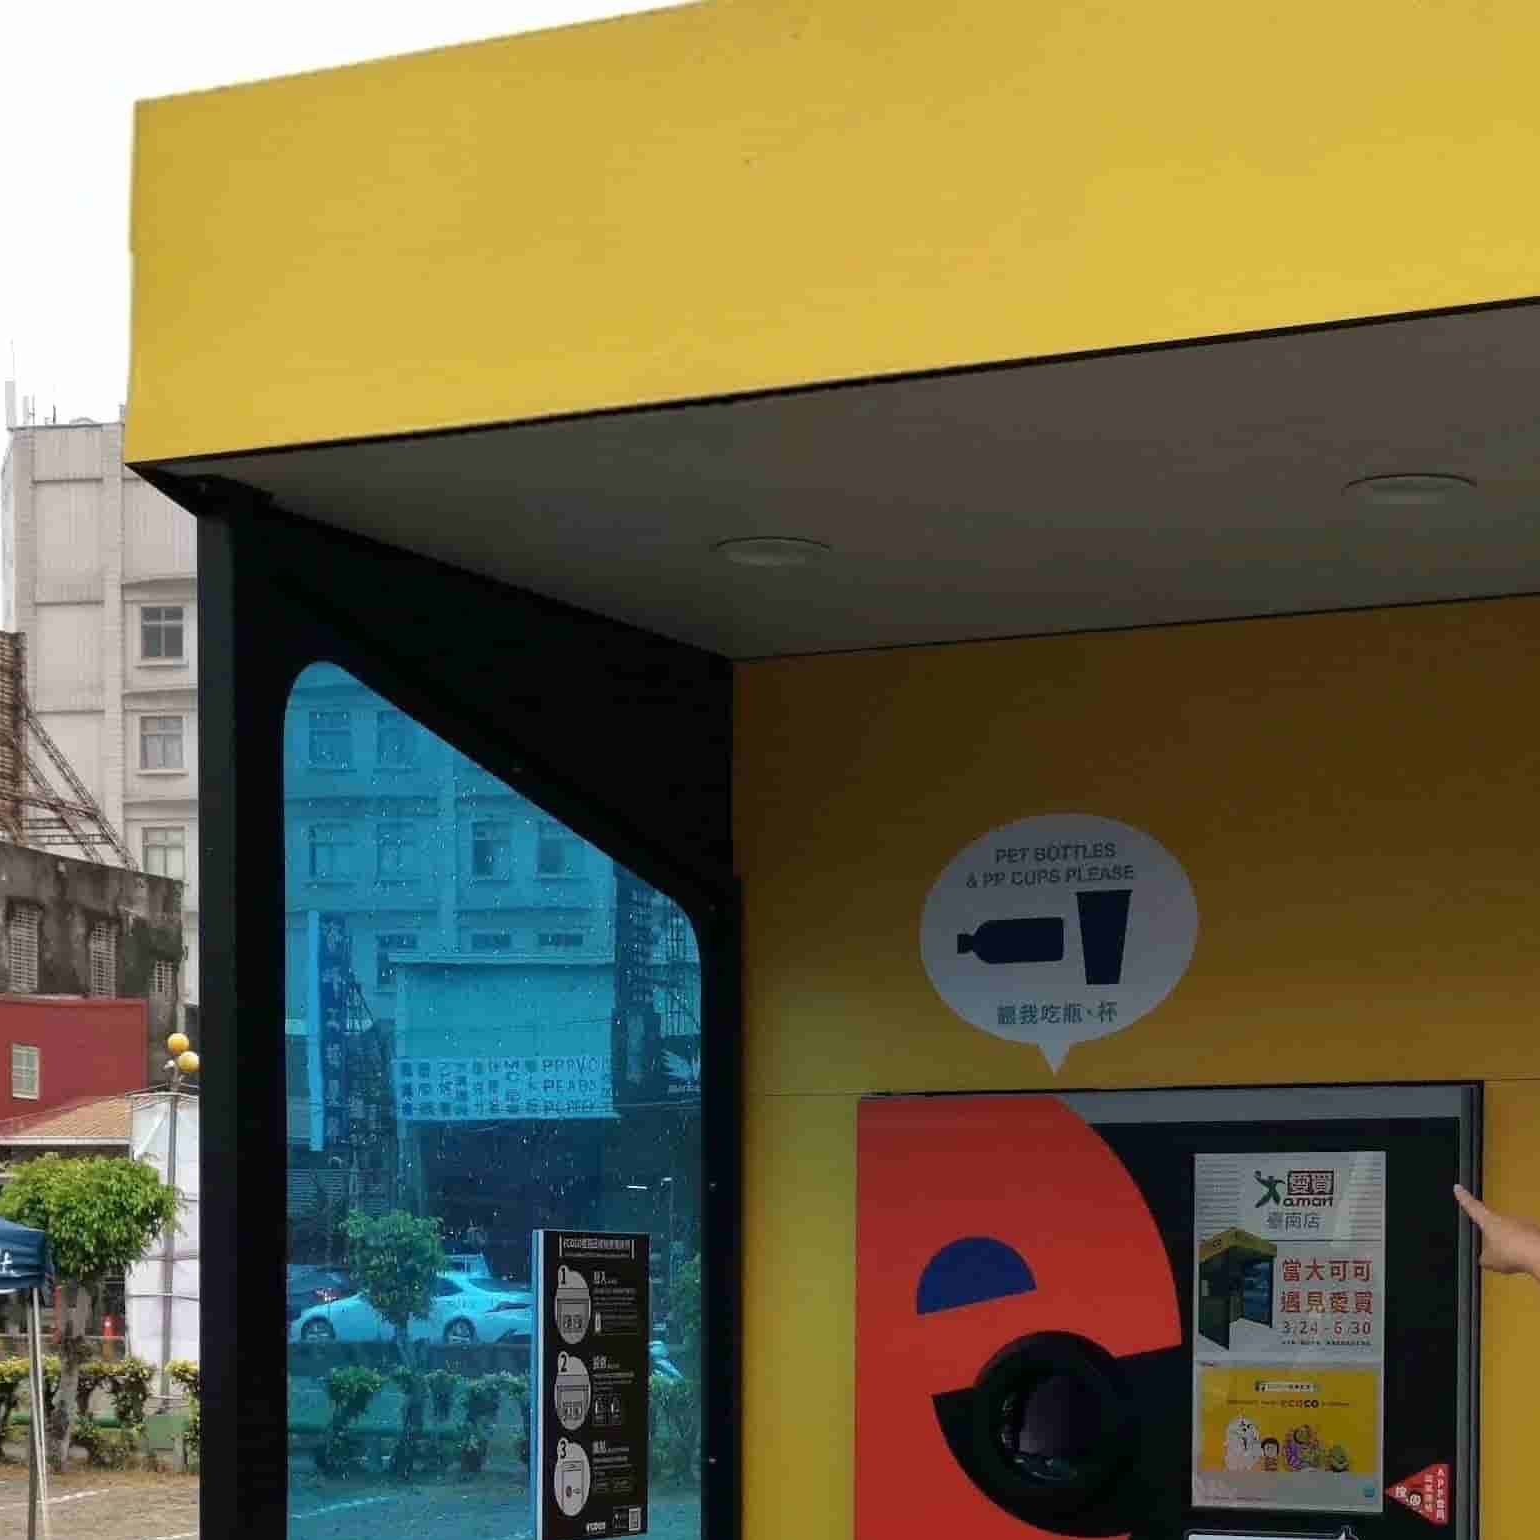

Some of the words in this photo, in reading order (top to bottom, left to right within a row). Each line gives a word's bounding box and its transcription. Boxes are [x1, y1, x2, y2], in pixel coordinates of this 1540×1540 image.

[995, 847, 1030, 864] PET
[1033, 842, 1117, 863] BOTTLES
[982, 872, 1007, 887] PP
[1011, 869, 1061, 885] CUPS
[1066, 865, 1134, 882] PLEASE
[1281, 1258, 1372, 1283] 當大可可
[1280, 1291, 1373, 1315] 遇見愛買
